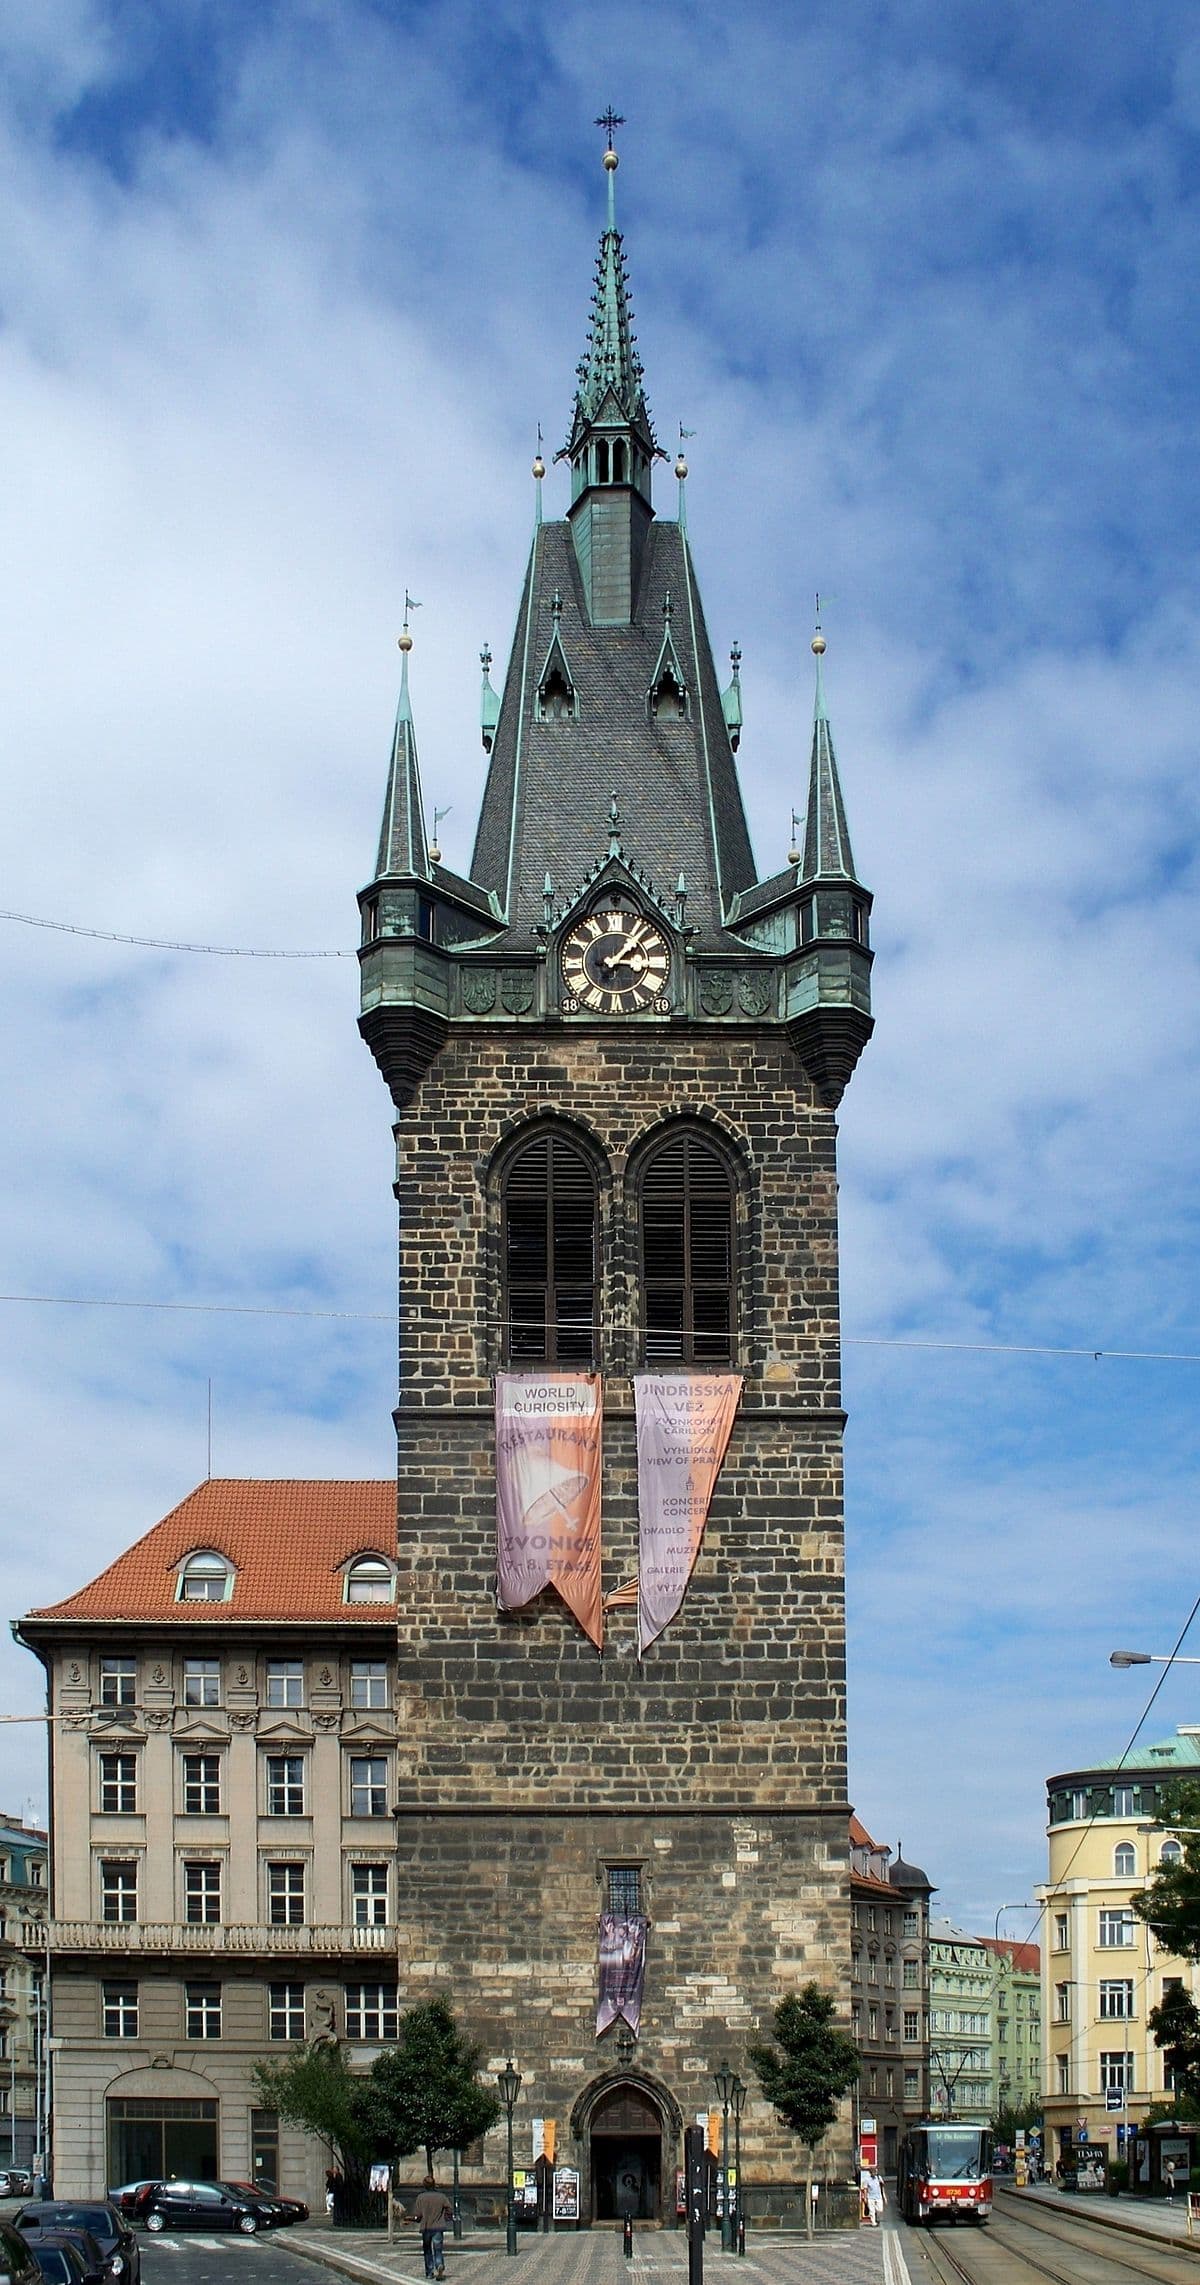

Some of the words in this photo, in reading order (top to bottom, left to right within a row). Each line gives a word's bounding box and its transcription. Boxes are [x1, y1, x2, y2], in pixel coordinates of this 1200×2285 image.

[524, 1387, 576, 1399] WORLD
[514, 1400, 586, 1413] CURIOSITY
[664, 1427, 715, 1435] CARILLON
[647, 1457, 672, 1465] VIEW
[675, 1456, 691, 1465] OF
[663, 1507, 707, 1516] CONCER
[503, 1534, 594, 1552] ZVONICE
[646, 1566, 685, 1575] GALERIE
